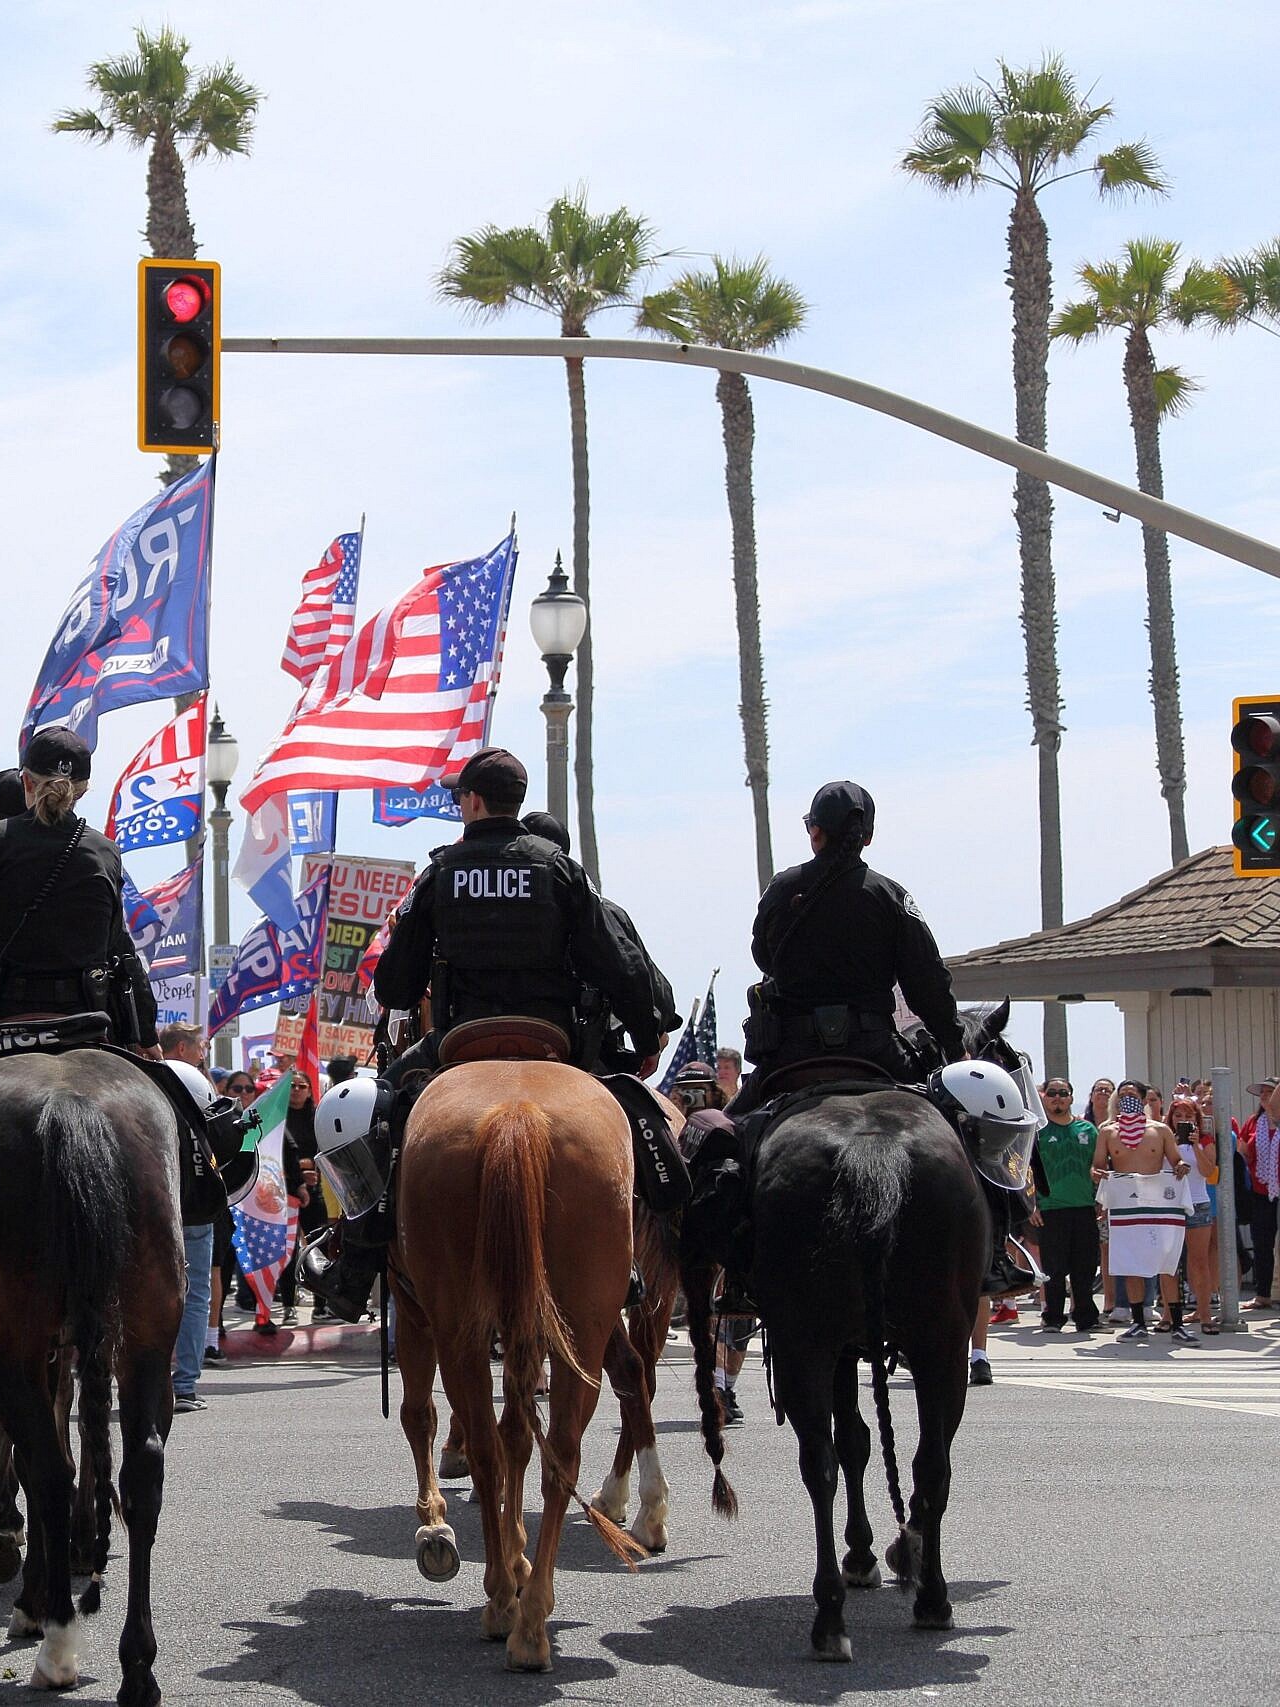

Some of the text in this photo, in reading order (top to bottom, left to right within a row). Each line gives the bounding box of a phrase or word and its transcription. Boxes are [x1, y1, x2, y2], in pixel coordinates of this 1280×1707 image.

[354, 869, 412, 897] NEED
[453, 869, 531, 899] POLICE
[325, 1027, 354, 1043] SAVE
[638, 1118, 670, 1184] POLICE
